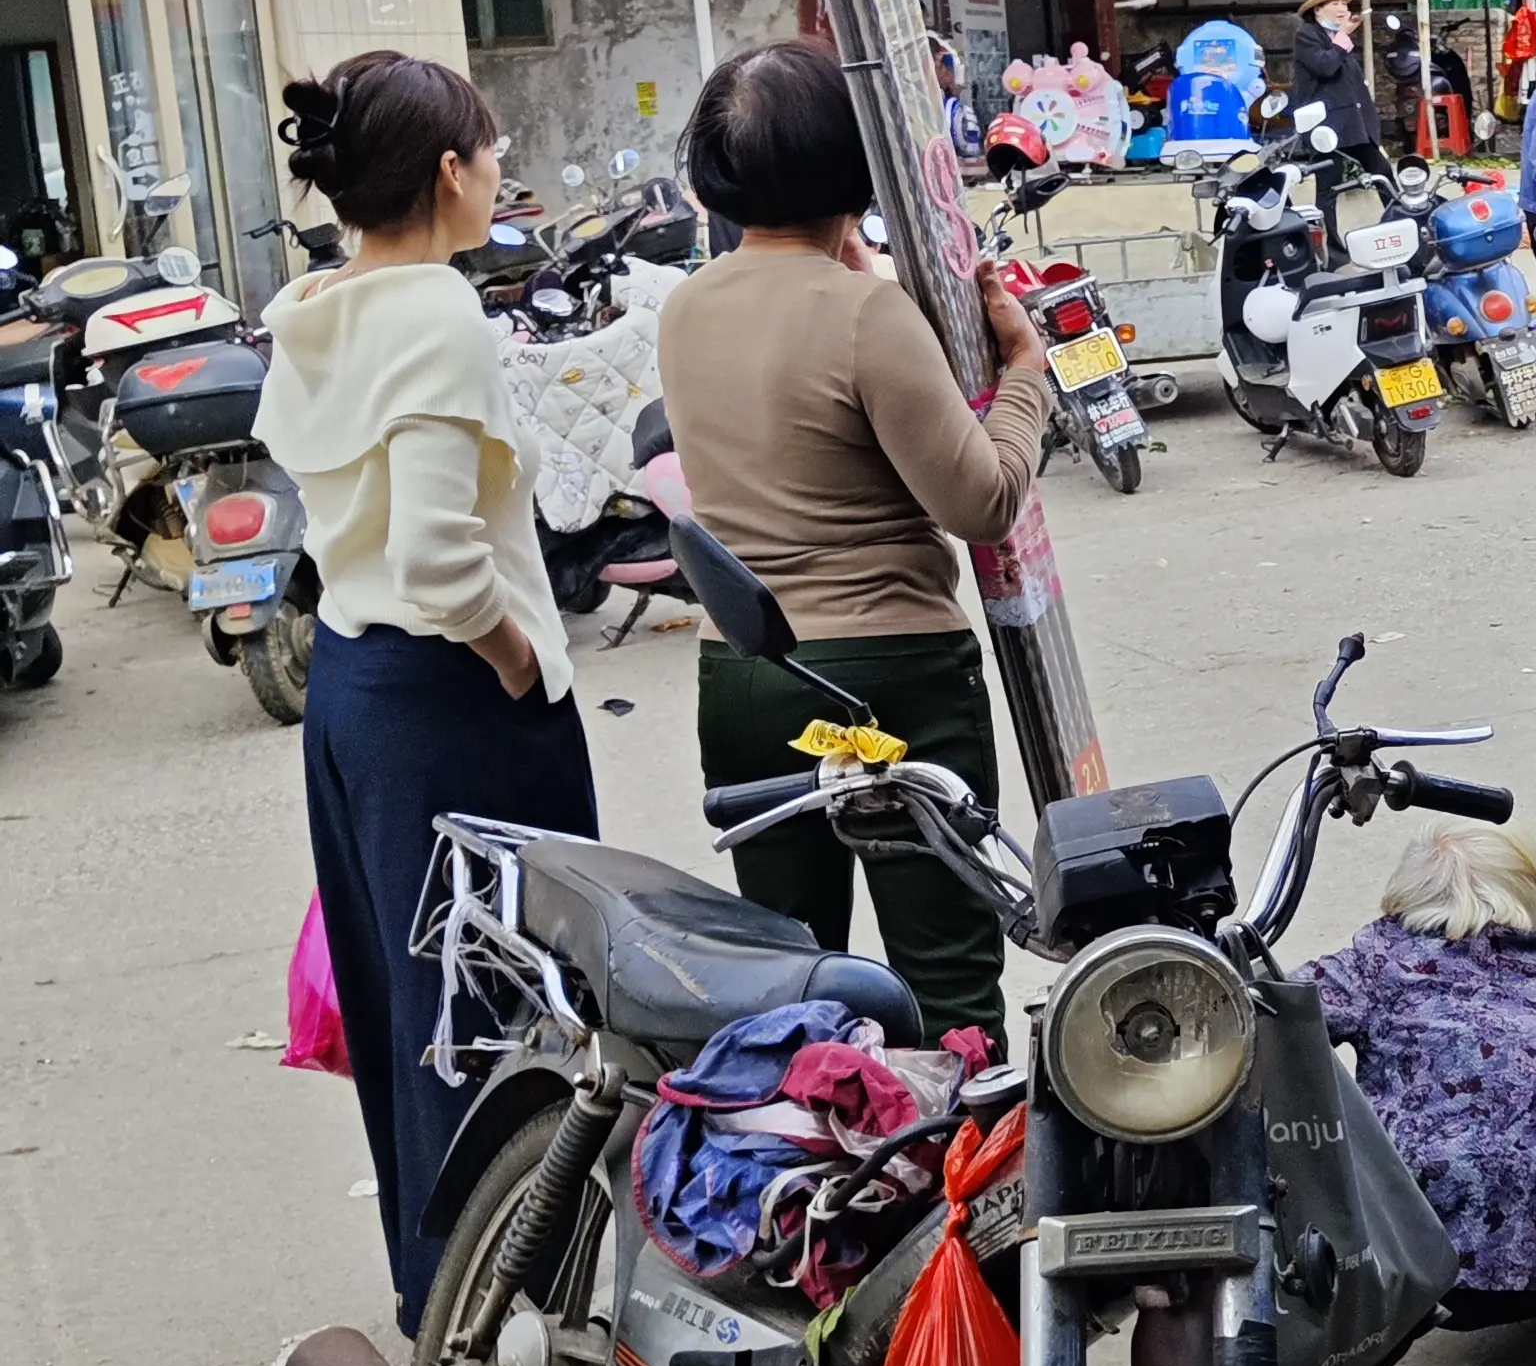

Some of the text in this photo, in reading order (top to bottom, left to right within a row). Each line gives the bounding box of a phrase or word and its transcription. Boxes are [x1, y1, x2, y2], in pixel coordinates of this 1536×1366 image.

[517, 348, 549, 366] day
[1062, 350, 1119, 386] PE610
[1385, 377, 1438, 404] TV306
[1075, 1224, 1229, 1255] FEIYING
